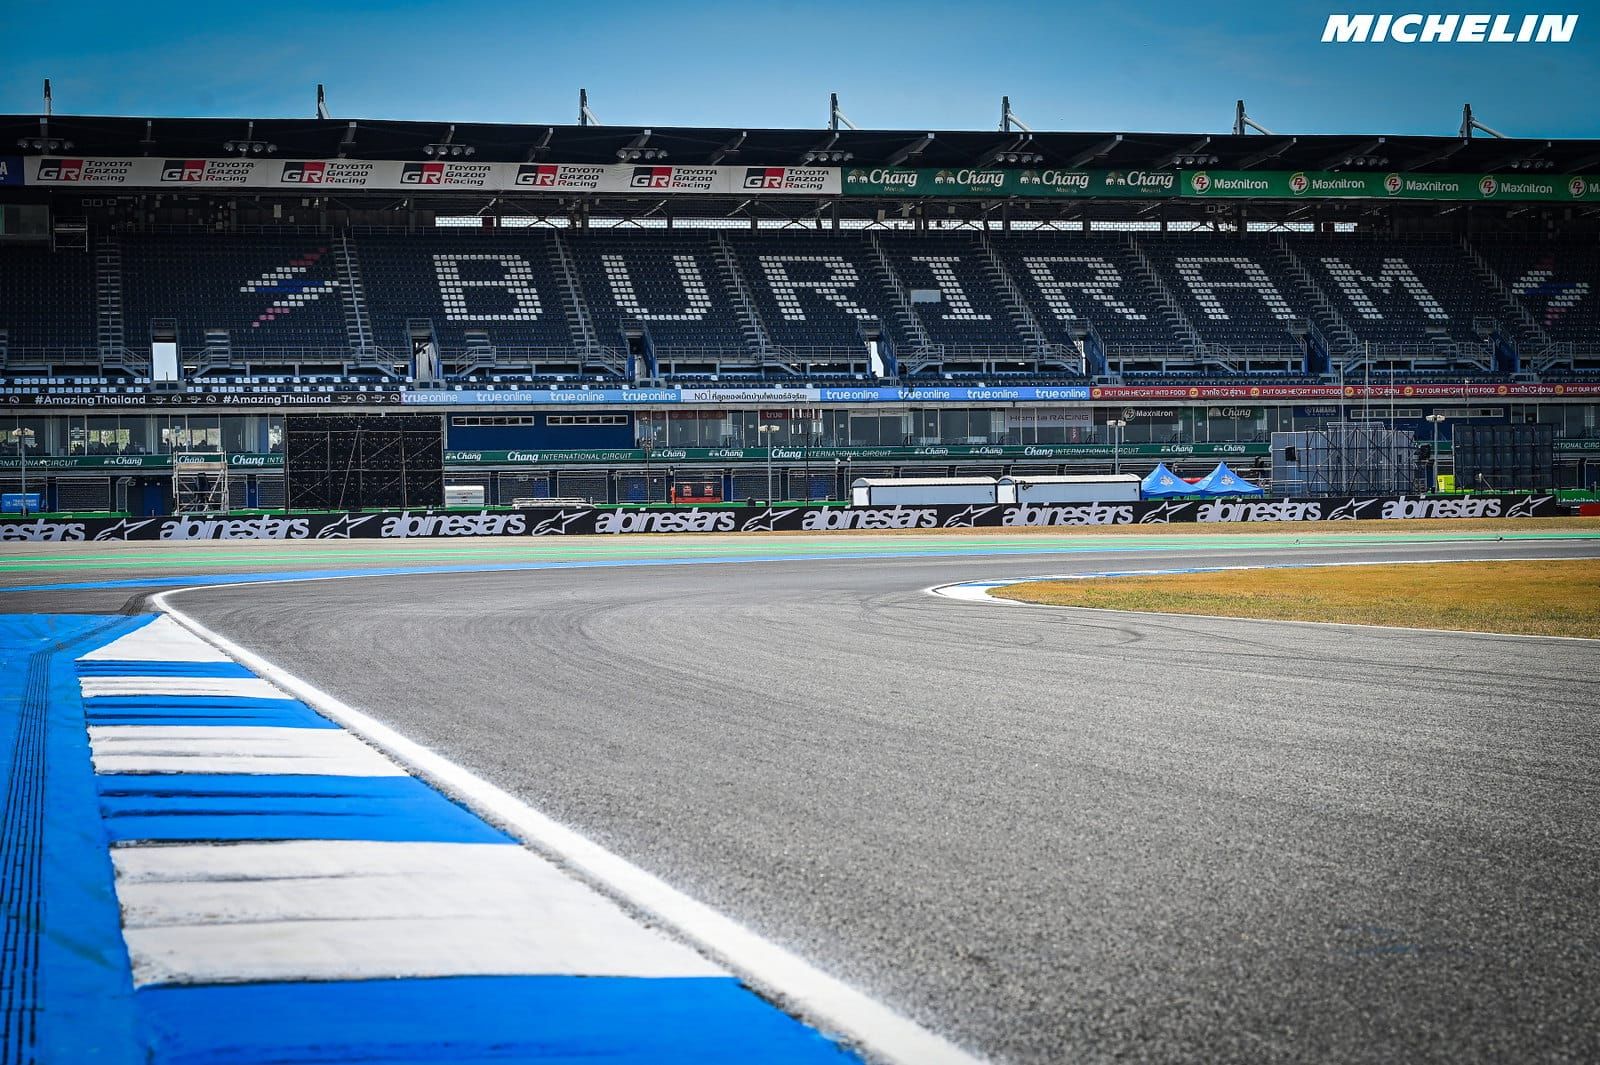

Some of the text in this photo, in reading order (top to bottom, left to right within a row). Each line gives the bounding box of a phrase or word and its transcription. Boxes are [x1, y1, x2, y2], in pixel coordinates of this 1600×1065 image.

[39, 168, 80, 181] GR
[561, 166, 604, 174] TOYOTA
[83, 174, 125, 182] Racing
[162, 169, 203, 183] GR
[206, 175, 247, 183] Racing
[282, 170, 323, 182] GR
[325, 177, 366, 185] Racing
[401, 171, 441, 184] GR
[516, 173, 554, 186] GR
[631, 175, 669, 187] GR
[869, 169, 918, 187] Chang
[956, 170, 1004, 187] Chang
[1042, 170, 1090, 188] Chang
[1127, 171, 1174, 189] Chang
[444, 178, 484, 186] Racing
[558, 180, 597, 188] Racing
[744, 176, 782, 188] GR
[785, 182, 823, 190] Racing
[1214, 179, 1269, 189] Maxnitron
[1312, 179, 1365, 190] Maxnitron
[1406, 180, 1459, 192] Maxnitron
[1501, 183, 1553, 194] Maxnitron
[433, 255, 1450, 321] BURIRAM
[402, 393, 458, 402] true online
[476, 392, 532, 401] true online
[550, 392, 604, 401] true online
[622, 391, 677, 401] true online
[826, 390, 879, 399] true online
[923, 389, 950, 399] online
[967, 389, 1019, 399] true online
[1035, 389, 1087, 398] true online
[34, 395, 146, 406] #AmazingThailand
[222, 395, 331, 405] #AmazingThailand
[1222, 407, 1251, 418] Chang
[662, 450, 686, 459] Chang
[719, 450, 743, 458] Chang
[772, 448, 801, 460] Chang
[925, 447, 949, 456] Chang
[980, 447, 1003, 455] Chang
[1025, 446, 1053, 457] Chang
[1171, 445, 1193, 453] Chang
[1224, 445, 1246, 453] Chang
[116, 457, 142, 466] Chang
[232, 454, 264, 466] Chang
[457, 452, 482, 461] Chang
[507, 452, 538, 463] Chang
[1197, 498, 1321, 522] alpinestars
[1381, 495, 1501, 519] alpinestars
[801, 505, 938, 530] alpinestars
[1002, 502, 1133, 526] alpinestars
[381, 509, 526, 538] alpinestars
[595, 507, 735, 534] alpinestars
[160, 515, 309, 540] alpinestars
